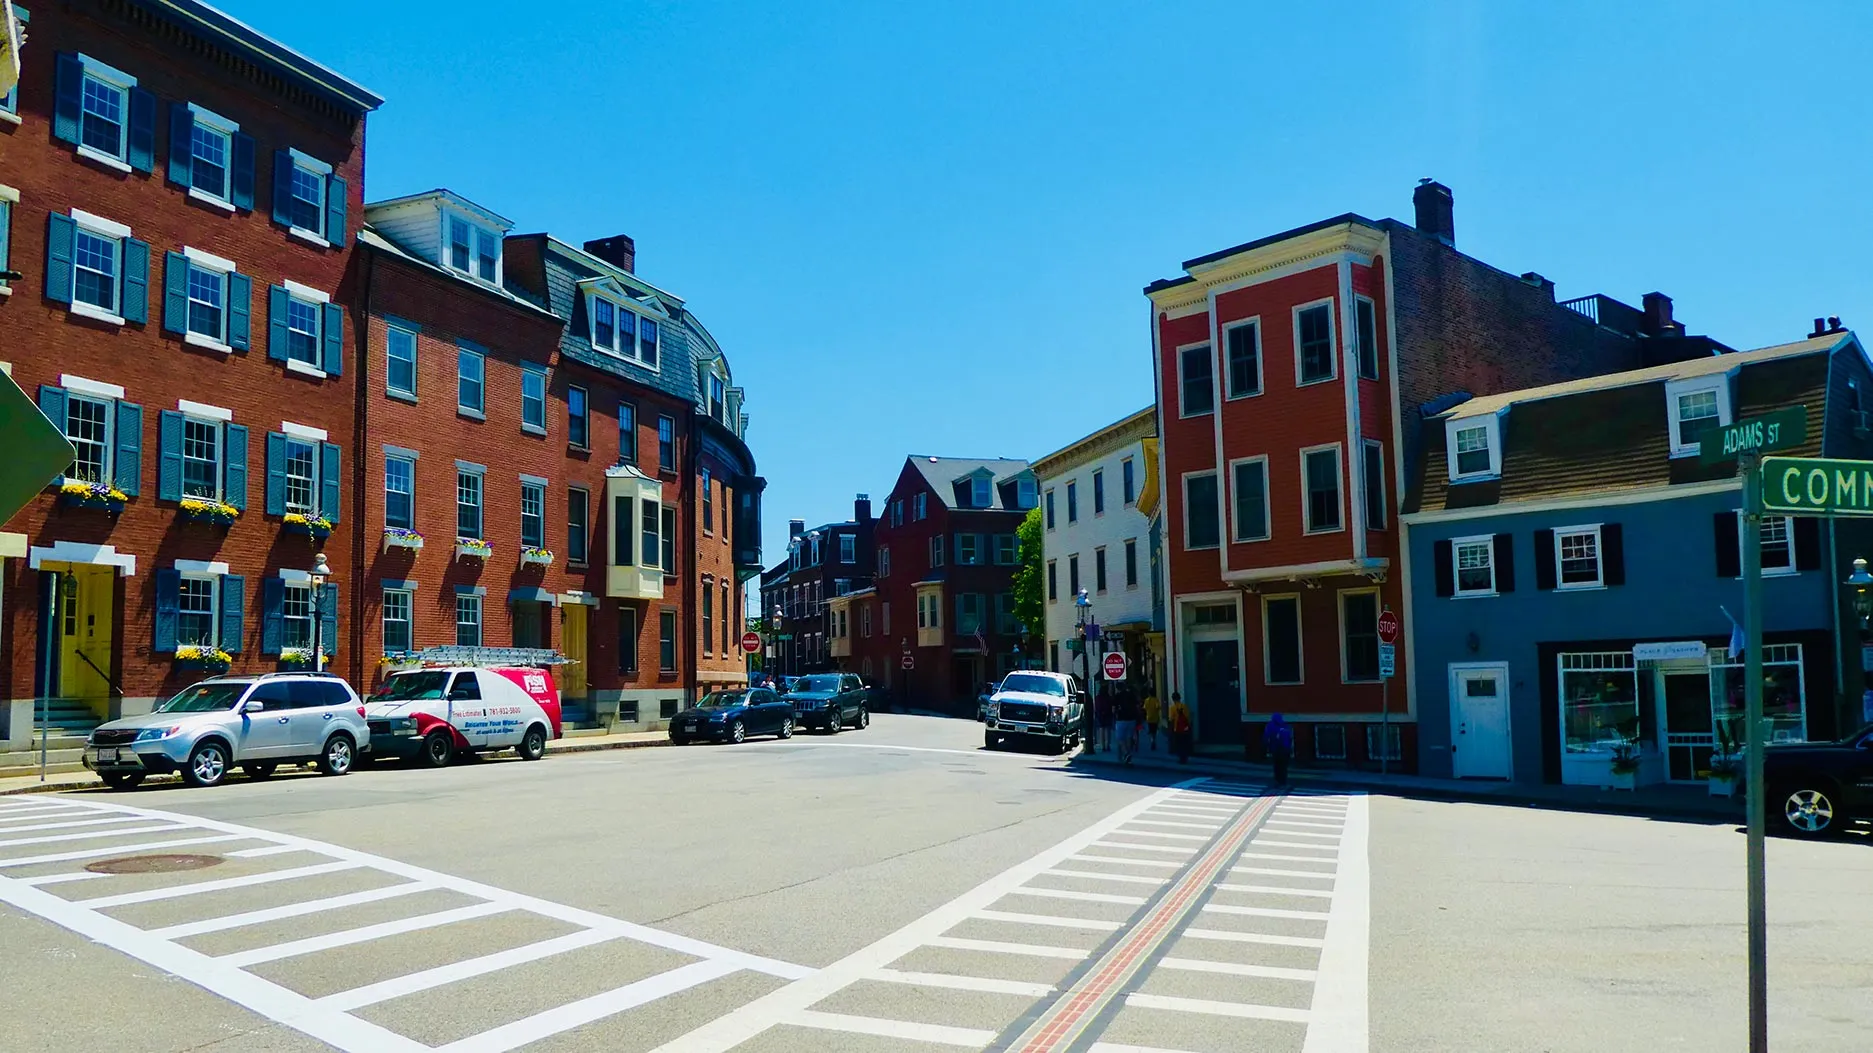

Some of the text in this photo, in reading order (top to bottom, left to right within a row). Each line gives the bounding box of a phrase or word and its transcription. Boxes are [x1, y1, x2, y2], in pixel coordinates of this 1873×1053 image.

[1723, 421, 1781, 455] ADAMS ST
[1380, 621, 1396, 633] STOP
